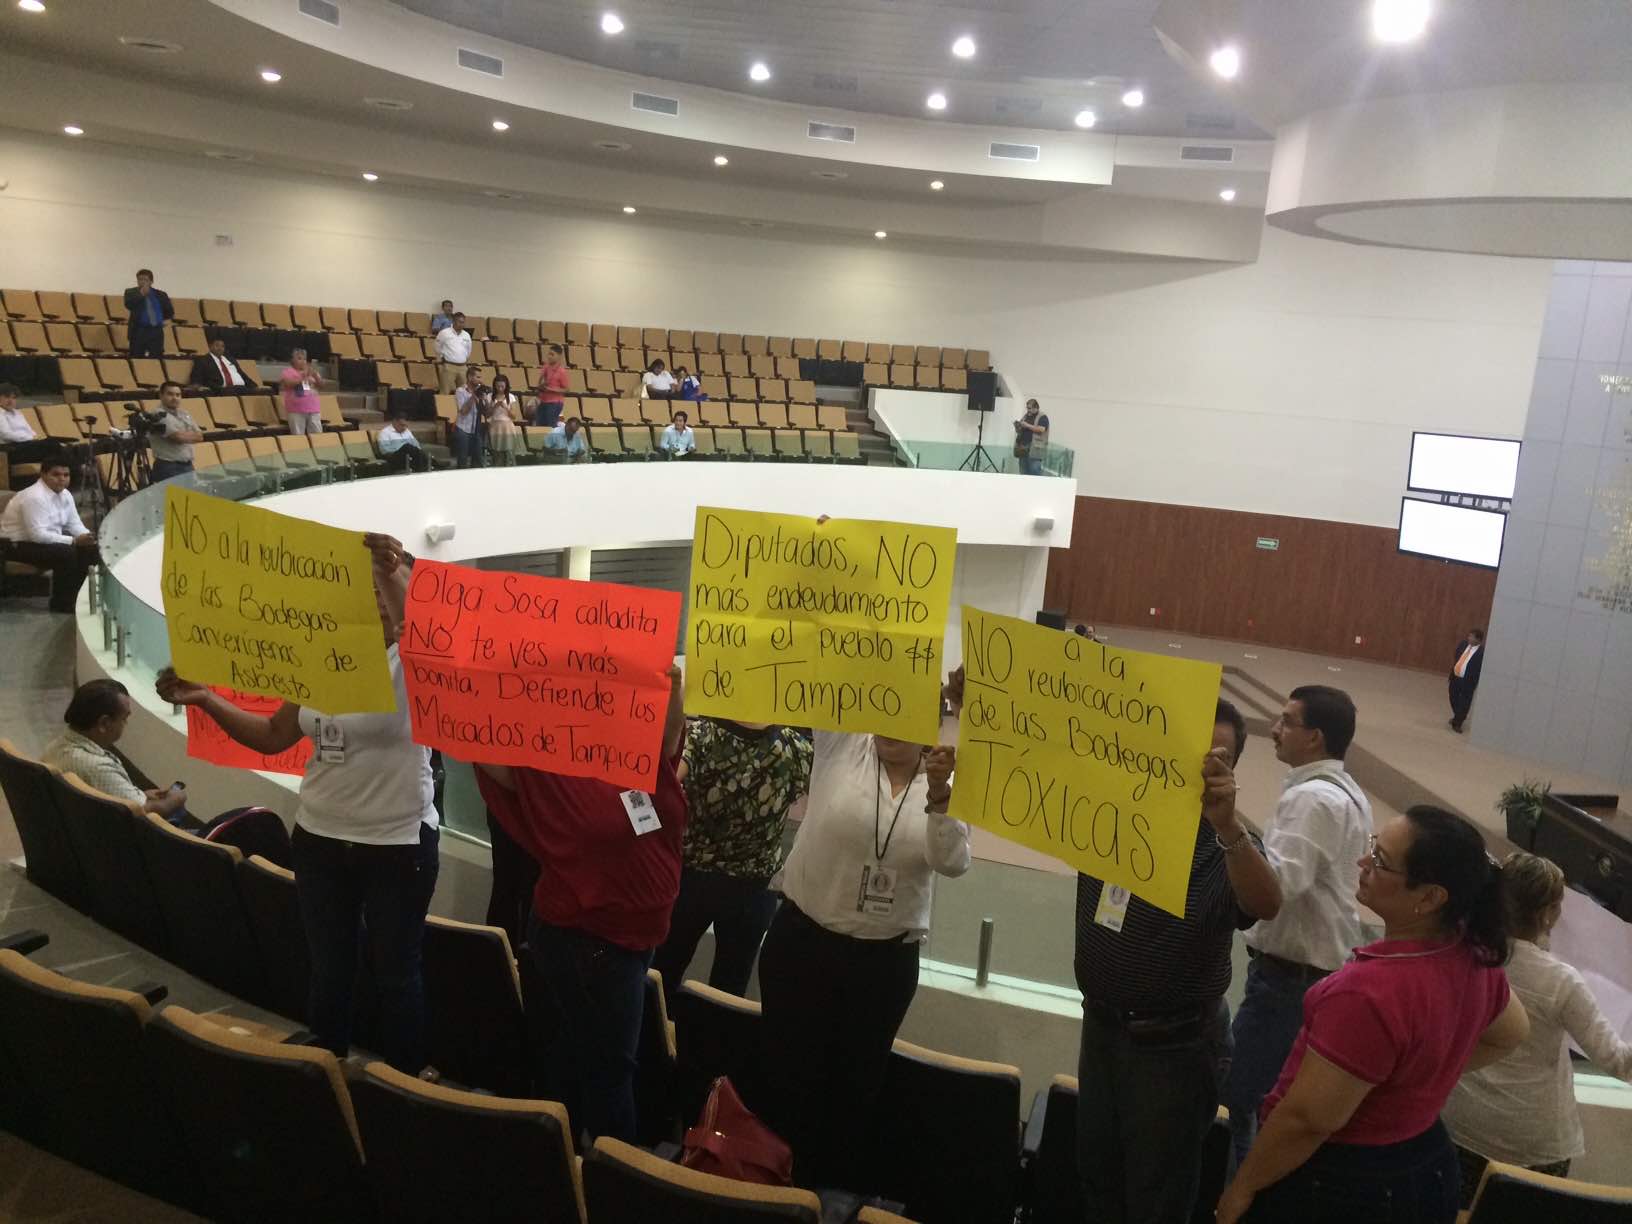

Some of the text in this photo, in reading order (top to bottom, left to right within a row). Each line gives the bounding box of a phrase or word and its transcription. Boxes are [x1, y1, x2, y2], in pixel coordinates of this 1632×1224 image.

[219, 531, 230, 560] a
[236, 520, 249, 565] la
[702, 514, 937, 588] Diputados, NO
[166, 562, 338, 642] de las Bodegas
[411, 568, 658, 635] Olga Sosa calladita
[696, 574, 928, 624] más endeudamiento
[324, 648, 357, 672] de
[409, 618, 618, 675] NO te ves más
[696, 619, 746, 657] para
[770, 619, 793, 650] el
[820, 627, 892, 662] pueblo
[966, 616, 1124, 683] NO a la
[231, 660, 311, 699] Asbesto
[412, 659, 656, 722] bonita, Defiende los
[703, 659, 901, 724] de Tampico
[1028, 669, 1167, 736] reubicación
[415, 695, 651, 775] Mercados de Tampico
[968, 694, 1185, 801] de las Bodegas
